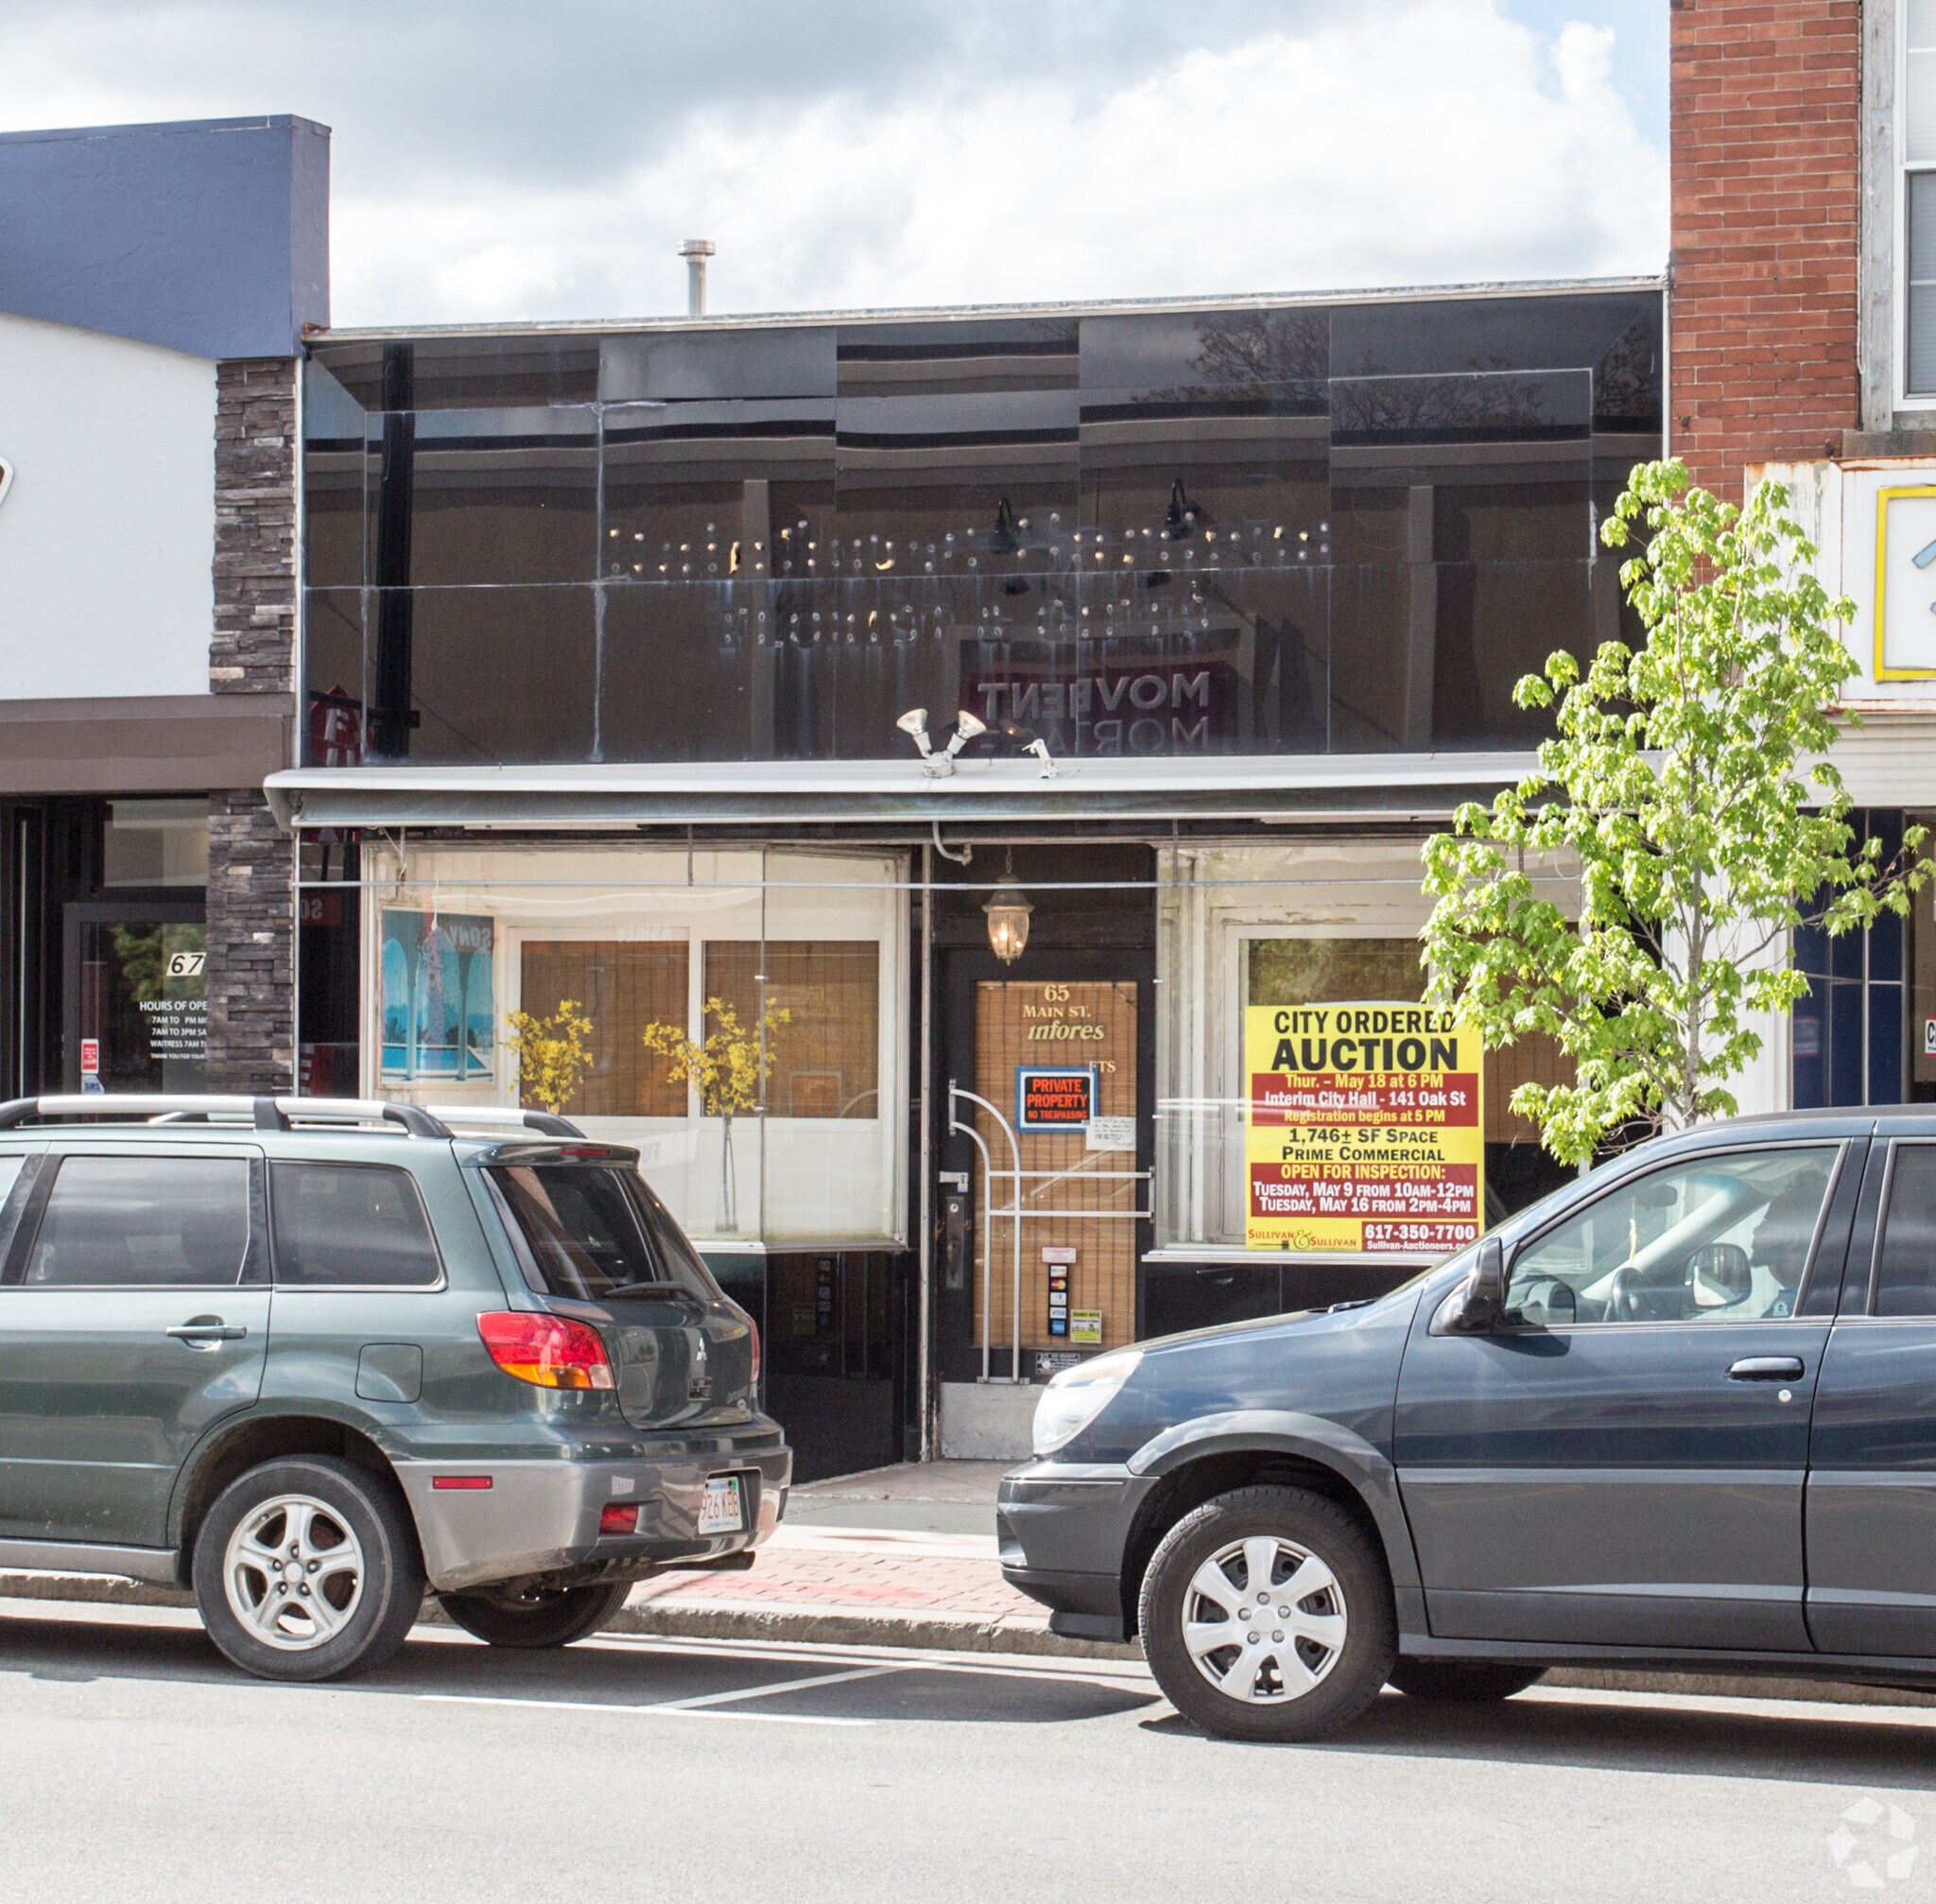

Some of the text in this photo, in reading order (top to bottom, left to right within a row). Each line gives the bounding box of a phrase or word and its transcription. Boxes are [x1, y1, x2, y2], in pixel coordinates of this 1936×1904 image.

[171, 954, 205, 974] 67
[1044, 984, 1070, 1001] 65
[140, 1001, 172, 1011] HOURS
[174, 1001, 187, 1011] OF
[1023, 1005, 1091, 1017] MAIN ST.
[1274, 1011, 1455, 1034] CITY ORDERED
[1270, 1038, 1458, 1071] AUCTION
[1032, 1079, 1082, 1093] PRIVATE
[1286, 1074, 1320, 1088] Thur.
[1335, 1074, 1364, 1090] May
[1368, 1074, 1385, 1087] 18
[1390, 1075, 1404, 1087] at
[1408, 1074, 1416, 1087] 6
[1421, 1074, 1443, 1087] PM
[1027, 1095, 1087, 1108] PROPERTY
[1265, 1091, 1315, 1105] Interim
[1319, 1091, 1344, 1109] City
[1349, 1091, 1376, 1106] Hall
[1389, 1092, 1415, 1105] 141
[1419, 1092, 1446, 1106] Oak
[1450, 1092, 1466, 1106] St
[1028, 1110, 1087, 1119] NO TRESPASSING
[1285, 1109, 1445, 1124] Registration begins at 5 PM
[1289, 1128, 1438, 1146] 1,746± SF SPACE
[1282, 1147, 1445, 1161] PRIME COMMERCIAL
[1281, 1165, 1445, 1179] OPEN FOR INSPECTION:
[1253, 1182, 1474, 1198] TUESDAY, MAY 9 FROM 10AM-12PM
[1260, 1197, 1470, 1213] TUESDAY, MAY 16 FROM 2PM-4PM
[1249, 1229, 1293, 1238] SULLIVAN
[1310, 1237, 1357, 1246] SULLIVAN
[1365, 1224, 1475, 1239] 617-350-7700
[701, 1494, 719, 1519] 926
